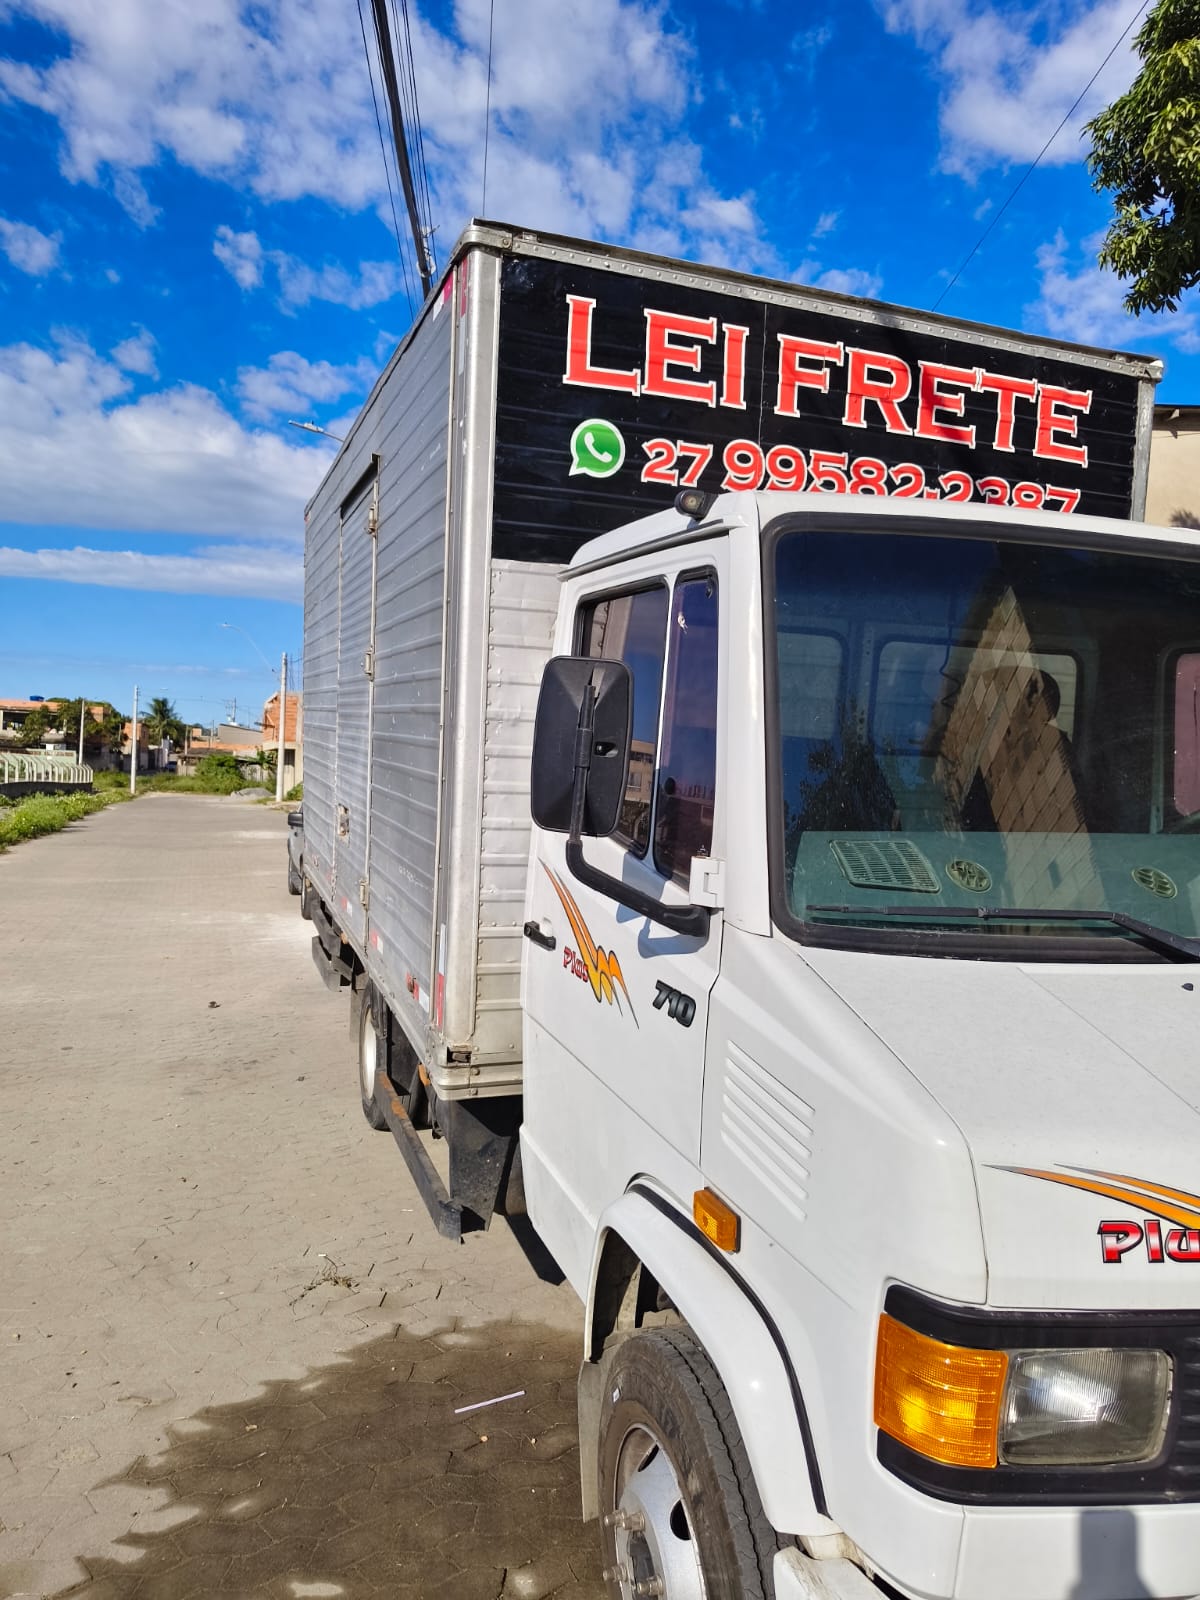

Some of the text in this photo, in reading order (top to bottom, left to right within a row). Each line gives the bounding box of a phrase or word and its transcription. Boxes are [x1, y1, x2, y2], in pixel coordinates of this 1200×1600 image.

[562, 294, 1093, 468] LEI FRETE
[641, 438, 713, 487] 27
[652, 979, 697, 1028] 710
